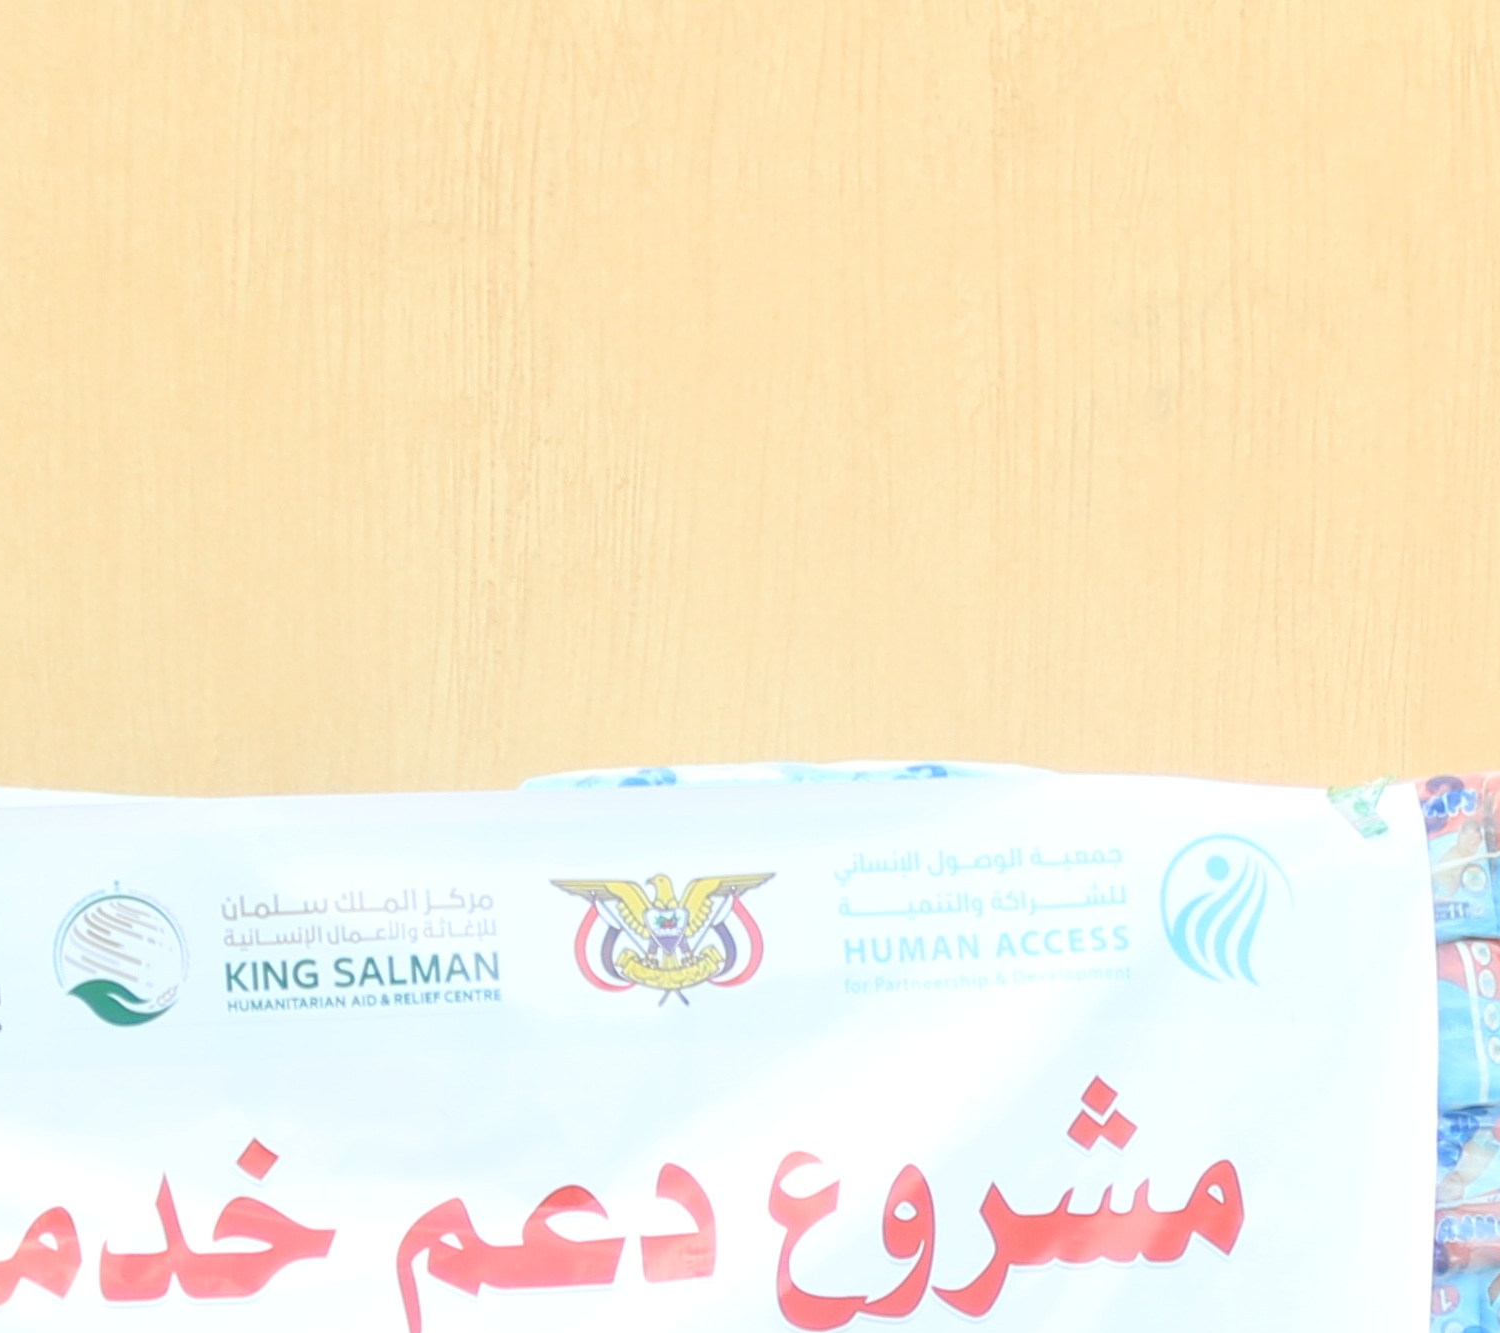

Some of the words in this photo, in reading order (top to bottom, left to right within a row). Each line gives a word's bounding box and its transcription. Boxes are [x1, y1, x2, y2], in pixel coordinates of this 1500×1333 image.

[220, 892, 329, 922] سلمان
[333, 888, 418, 915] الملك
[423, 886, 495, 917] مركز
[843, 934, 980, 965] HUMAN
[996, 924, 1130, 958] ACCESS
[223, 957, 320, 994] KING
[332, 951, 500, 989] SALMAN
[843, 978, 869, 995] for
[995, 970, 1007, 986] &
[1012, 966, 1132, 985] Development
[226, 994, 346, 1014] HUMANITARIAN
[349, 992, 377, 1009] AID
[380, 992, 390, 1007] &
[392, 989, 442, 1008] RELIEF
[443, 987, 502, 1004] CENTRE
[768, 1073, 1246, 1333] مشروع
